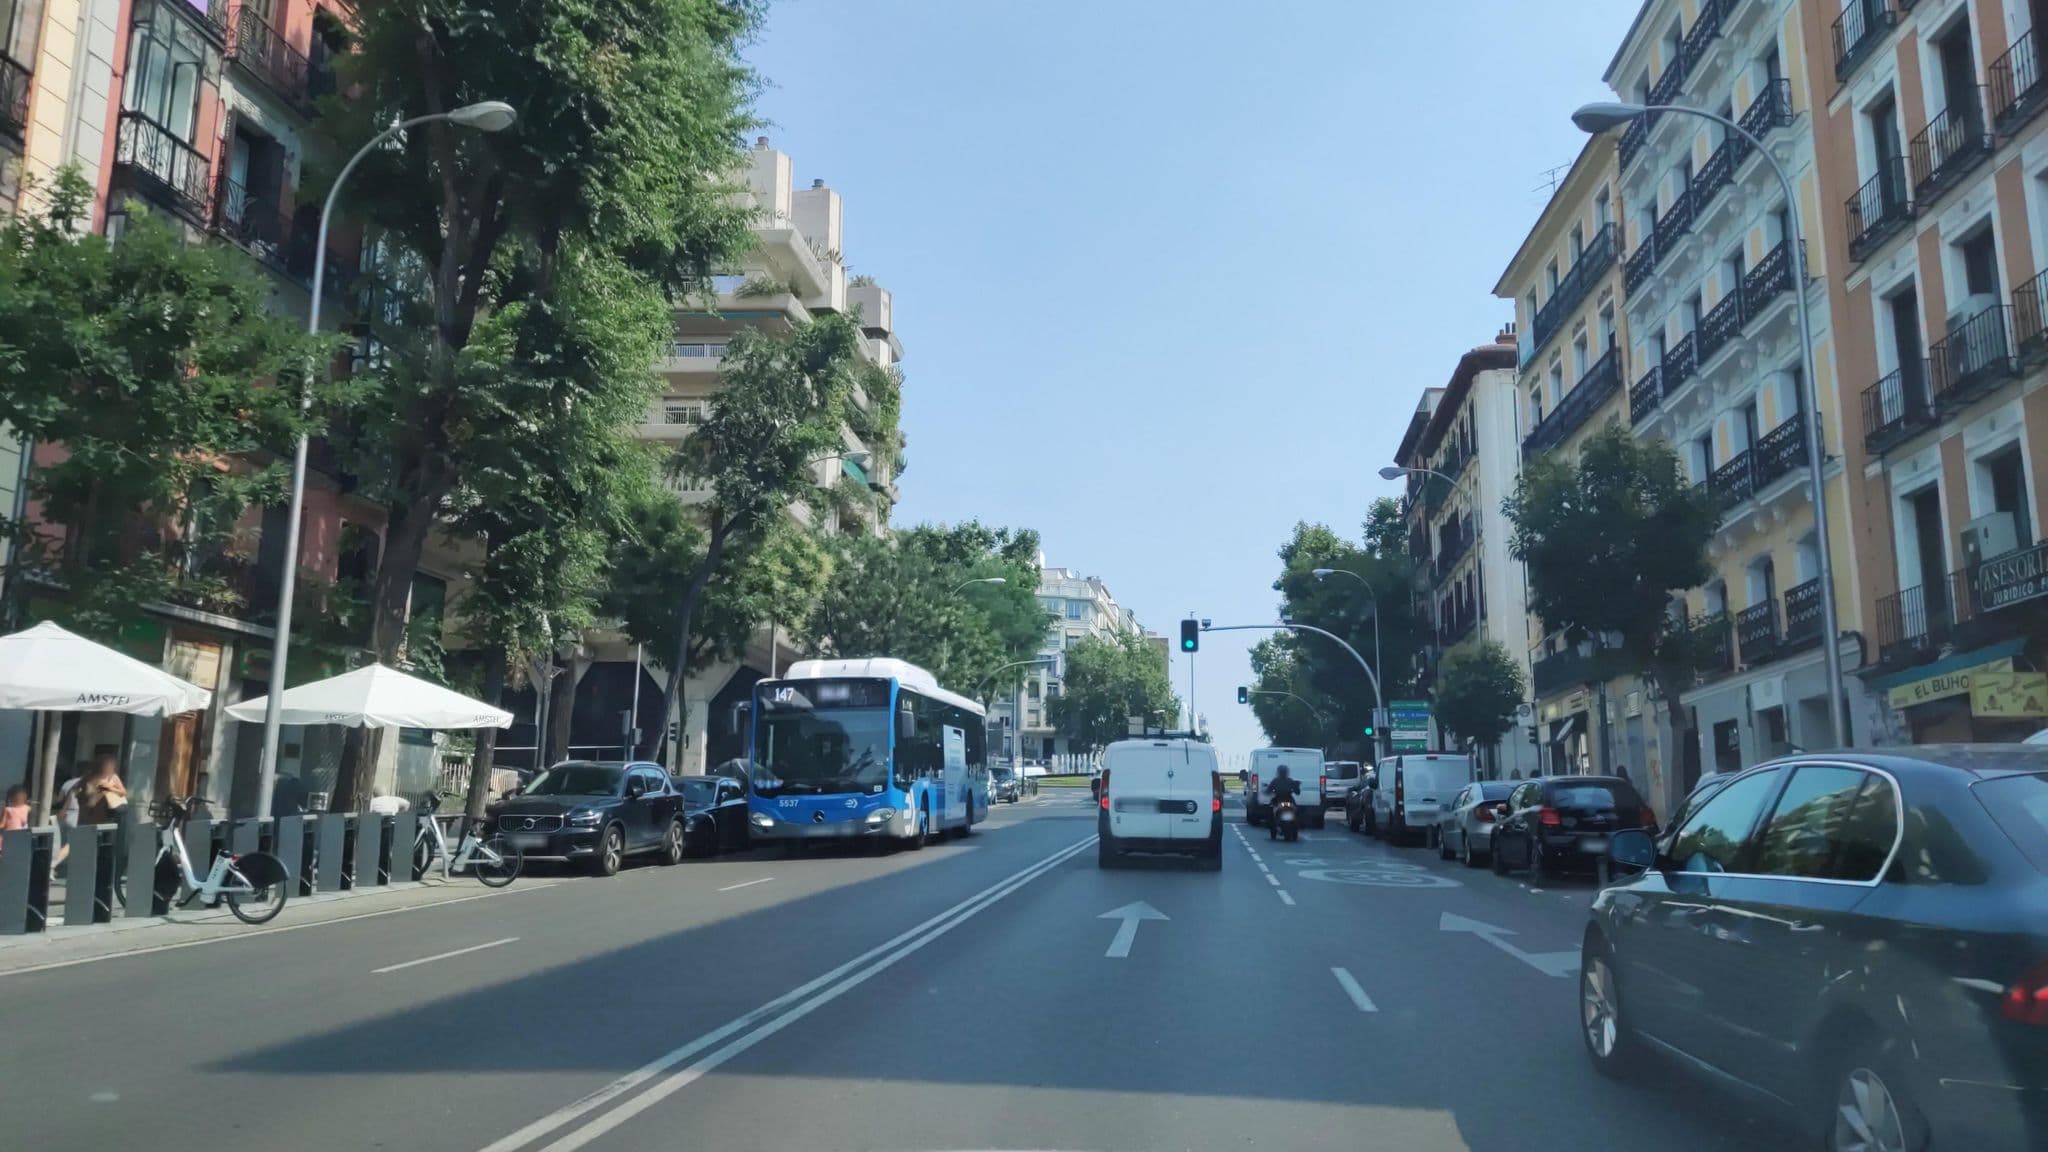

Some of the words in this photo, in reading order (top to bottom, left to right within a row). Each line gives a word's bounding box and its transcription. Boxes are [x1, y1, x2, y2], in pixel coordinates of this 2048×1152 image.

[1984, 550, 2048, 591] ASESORI
[775, 687, 794, 702] 147
[1914, 685, 1930, 699] EL
[1932, 675, 1970, 693] BUHO
[779, 799, 800, 808] 5537
